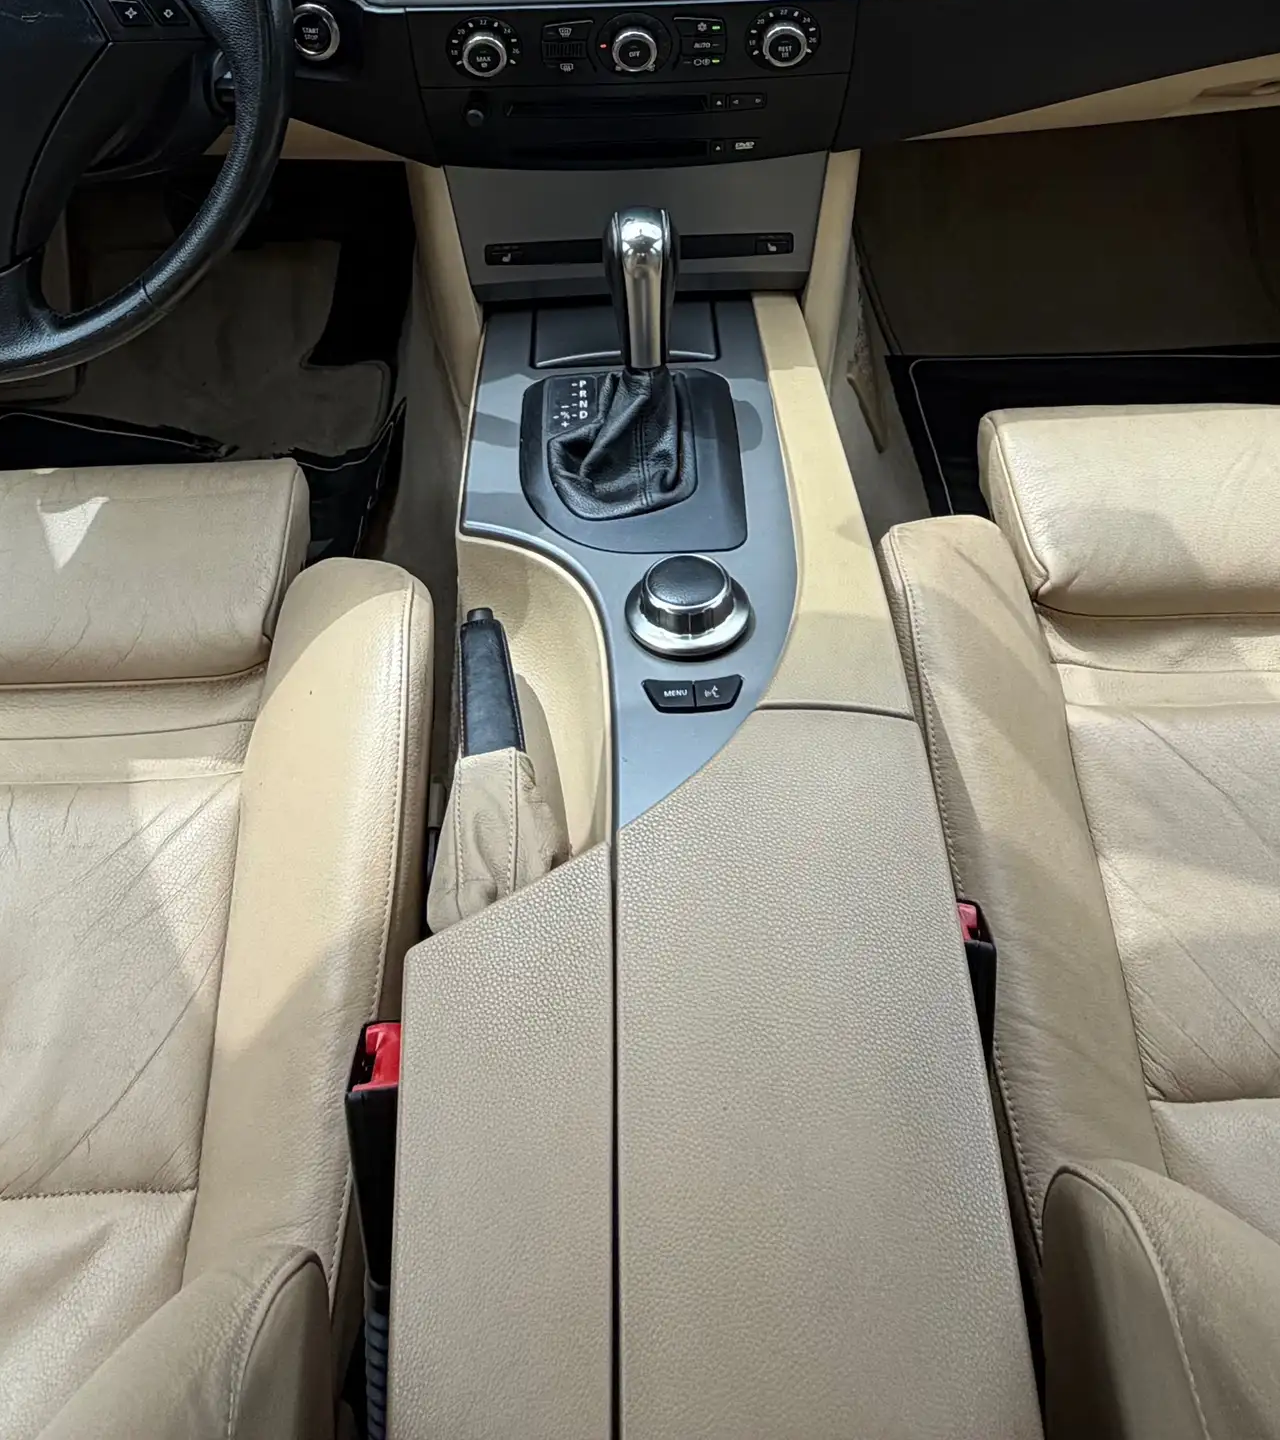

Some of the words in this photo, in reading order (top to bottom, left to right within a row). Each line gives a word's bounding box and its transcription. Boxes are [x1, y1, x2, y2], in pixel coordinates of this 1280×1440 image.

[579, 380, 587, 388] P
[579, 390, 587, 398] R
[579, 400, 588, 408] N
[579, 410, 588, 419] D
[663, 689, 688, 697] MENU
